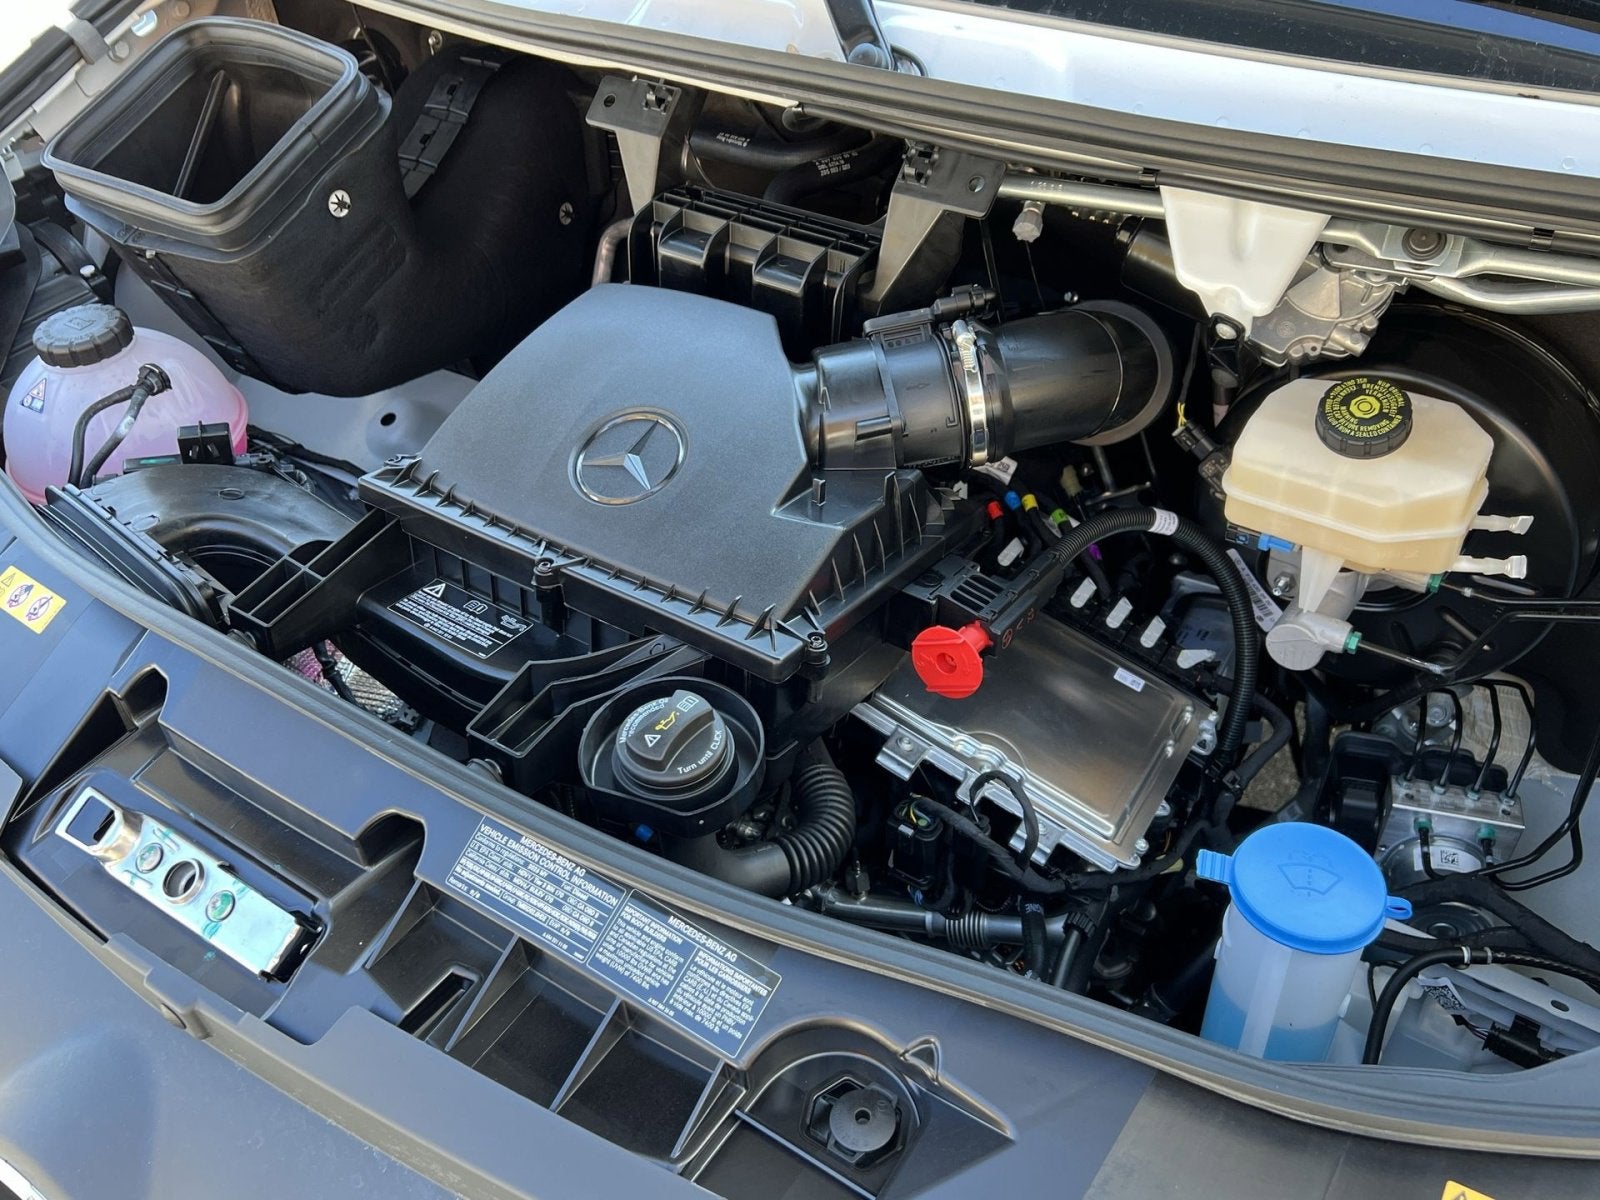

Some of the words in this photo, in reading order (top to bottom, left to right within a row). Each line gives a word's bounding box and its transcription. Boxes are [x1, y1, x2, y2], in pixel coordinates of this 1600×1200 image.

[1360, 419, 1390, 431] REMOVING
[677, 764, 698, 774] Turn
[698, 750, 713, 765] until
[710, 730, 723, 750] CLICK
[480, 824, 508, 844] VEHICLE
[507, 839, 540, 862] EMISSION
[539, 857, 571, 880] CONTROL
[570, 875, 618, 905] INFORMATION
[520, 837, 575, 870] MERCEDES-BENZ
[573, 866, 586, 877] AG
[668, 916, 726, 955] MERCEDES-BENZ
[724, 950, 737, 962] AG
